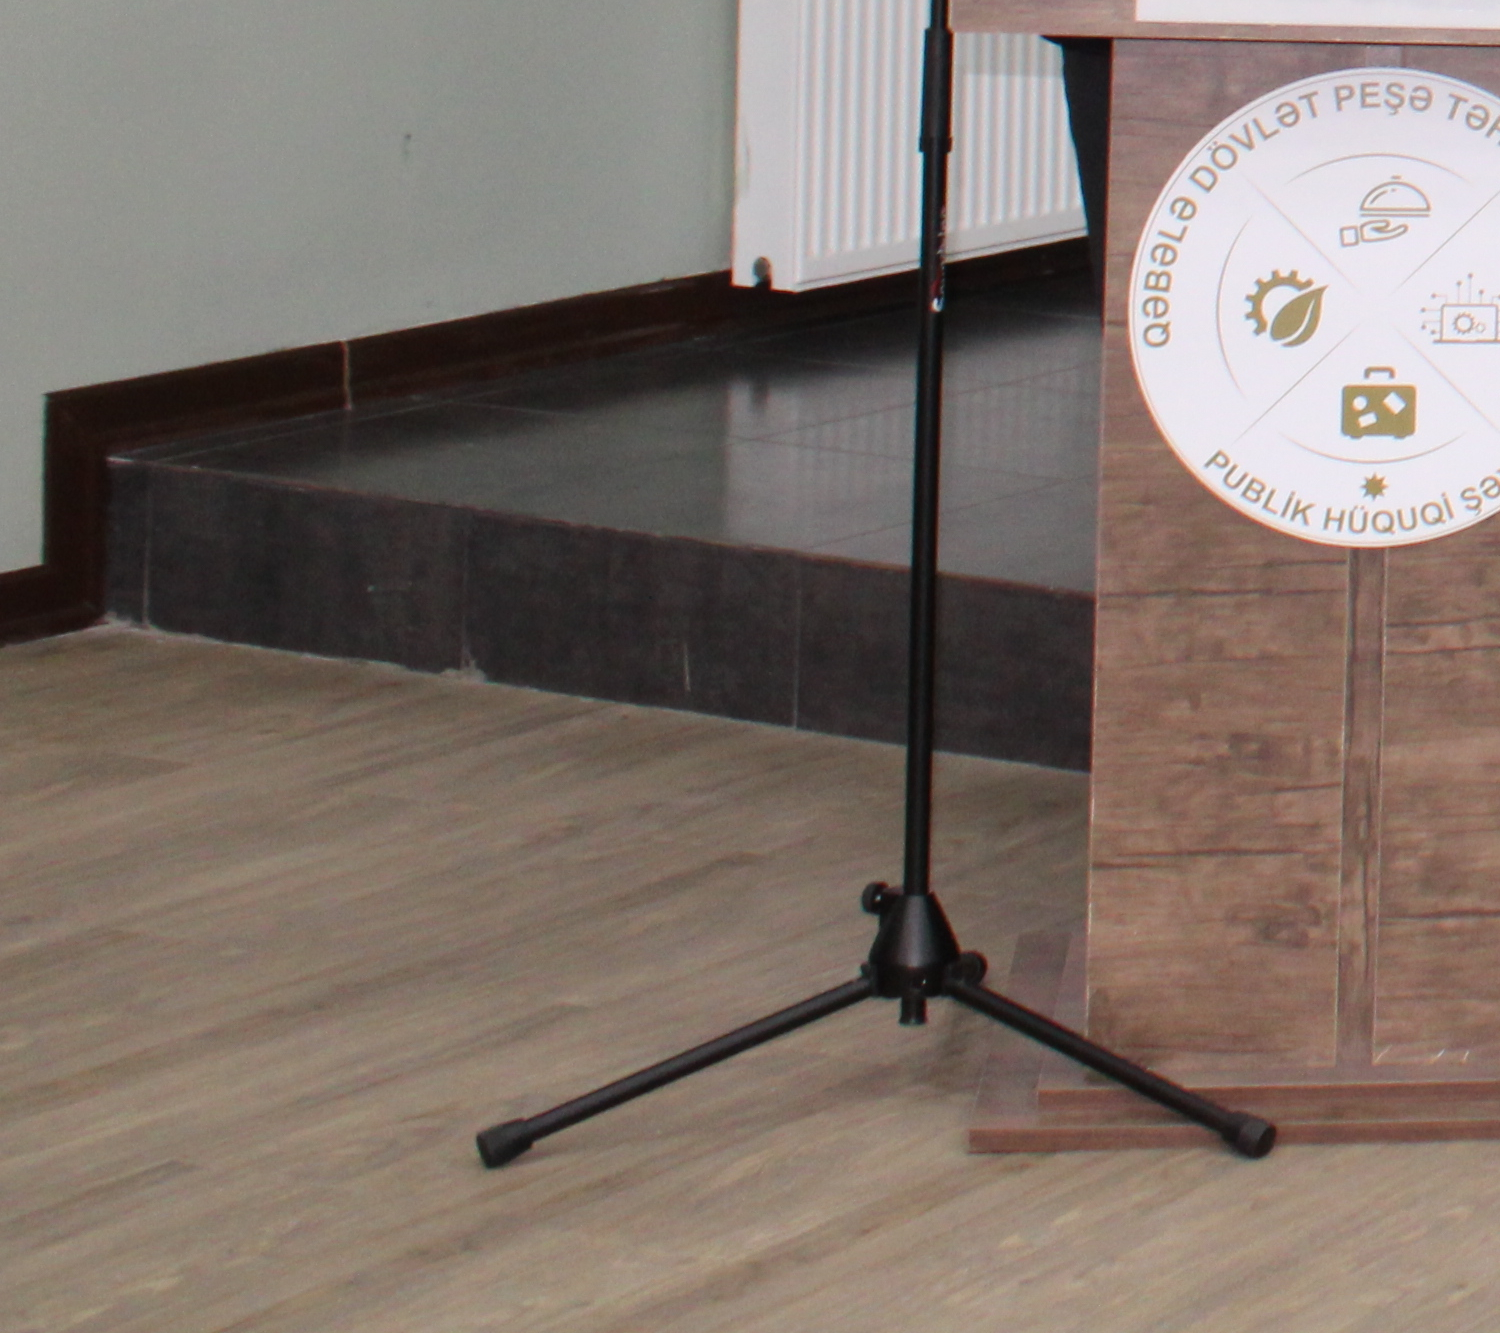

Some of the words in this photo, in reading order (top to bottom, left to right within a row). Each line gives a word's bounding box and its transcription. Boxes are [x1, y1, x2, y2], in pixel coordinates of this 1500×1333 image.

[1142, 195, 1199, 349] QƏBƏLƏ
[1188, 90, 1320, 194] DÖVLƏT
[1333, 81, 1435, 116] PEŞƏ
[1203, 449, 1318, 527] PUBLİK
[1322, 491, 1456, 535] HÜQUQİ
